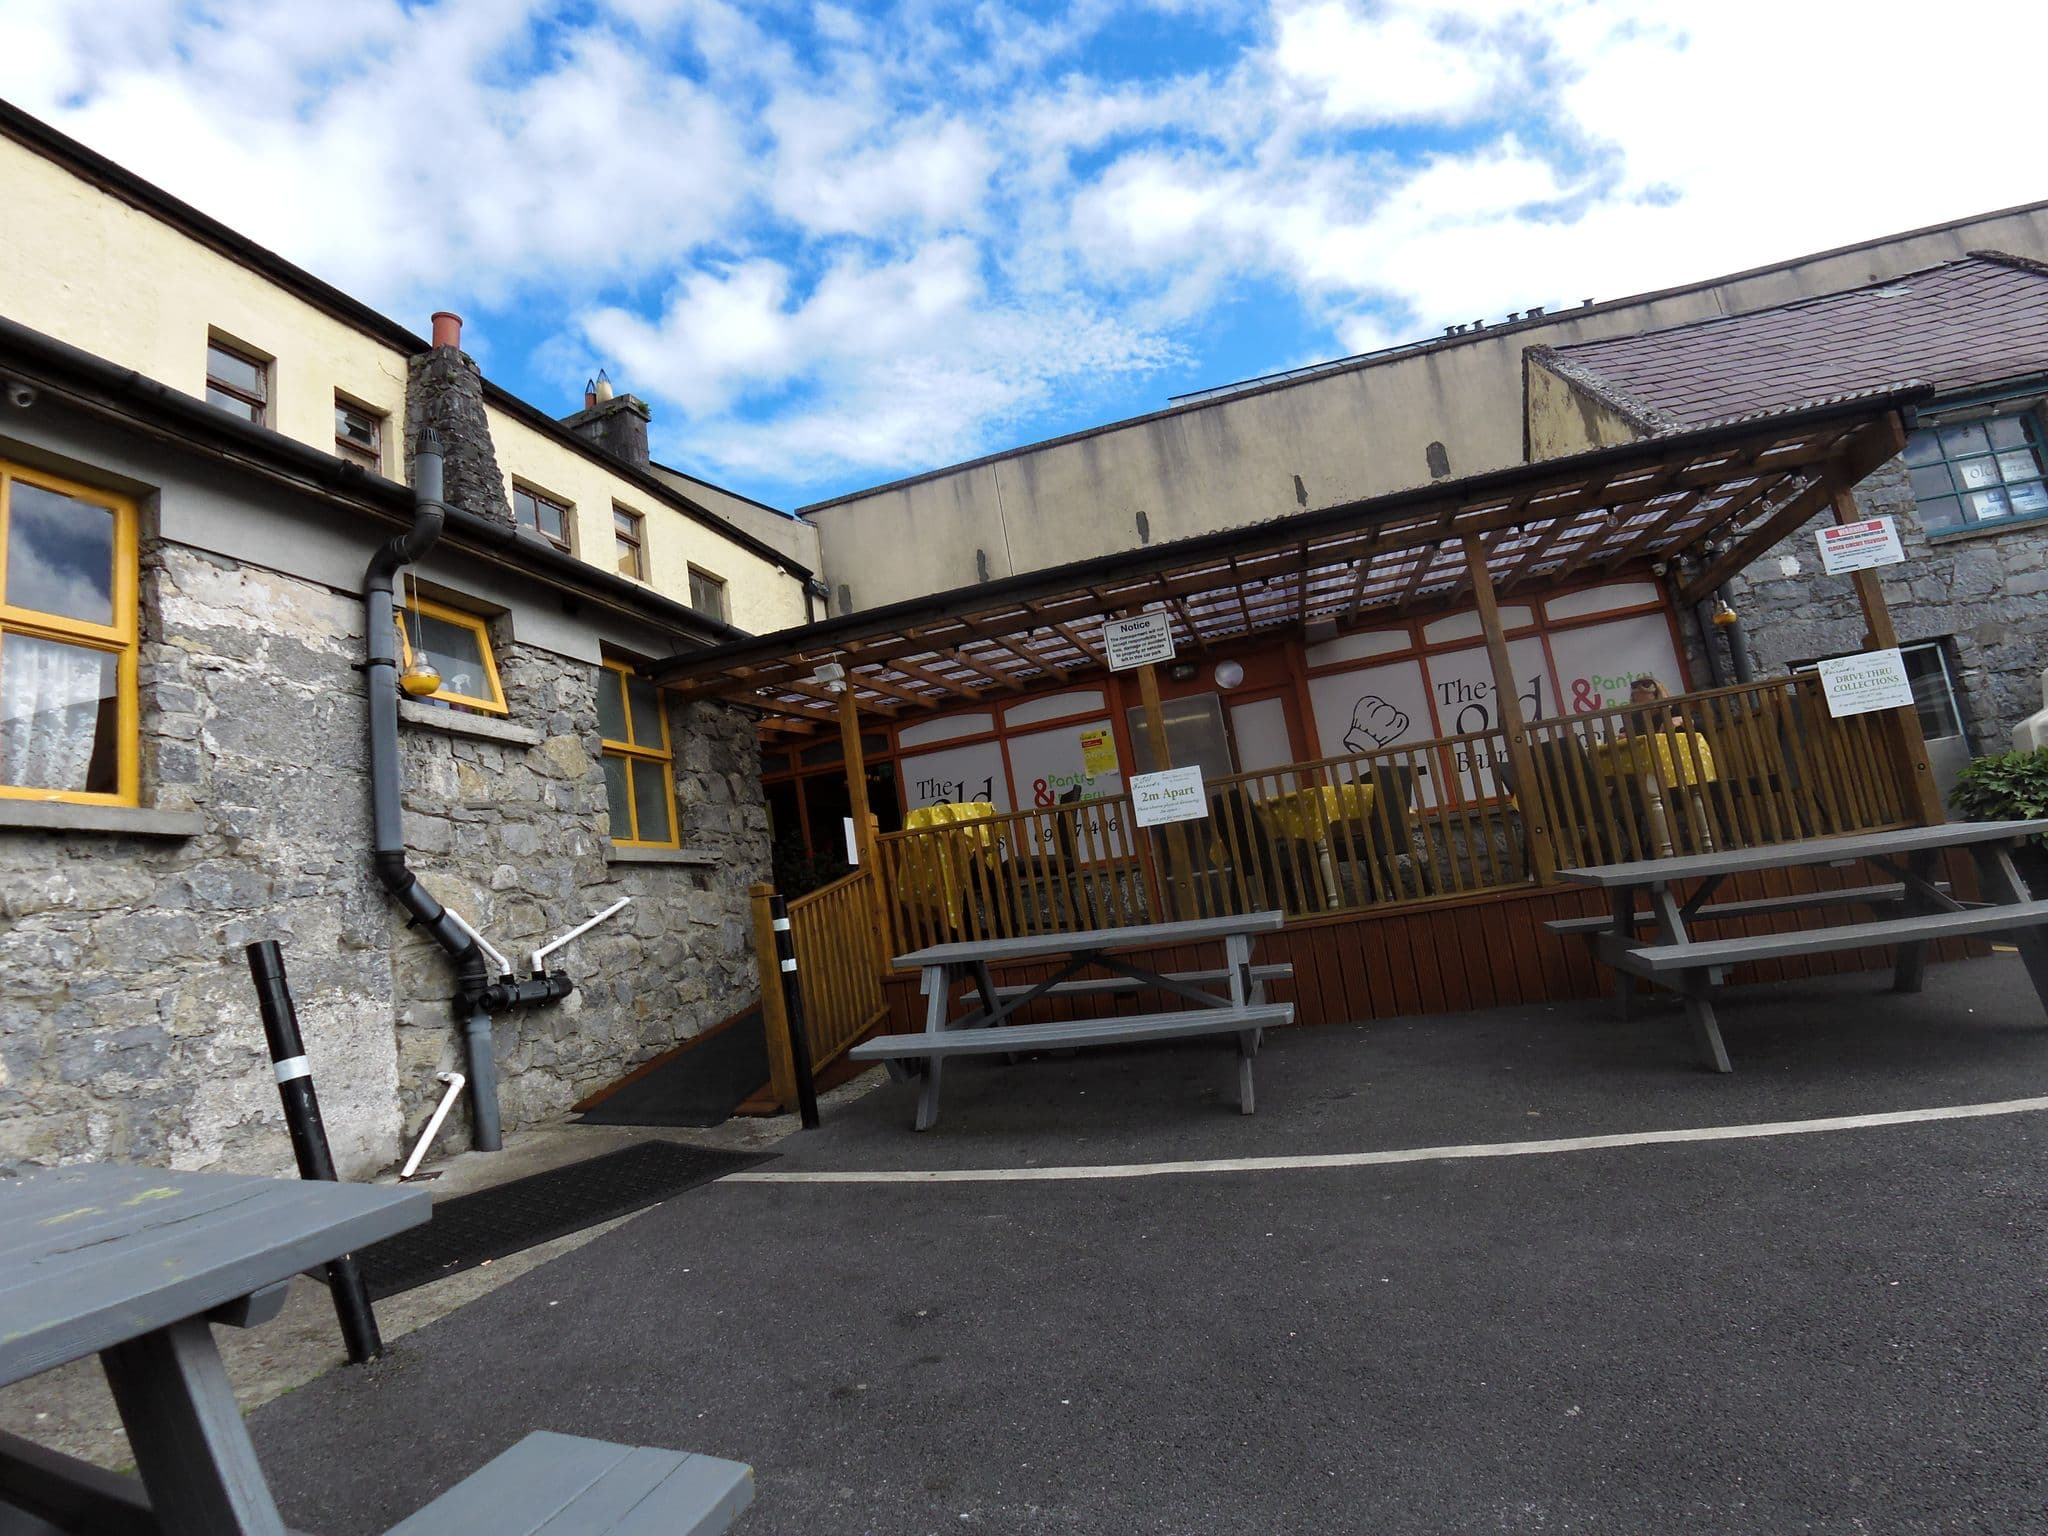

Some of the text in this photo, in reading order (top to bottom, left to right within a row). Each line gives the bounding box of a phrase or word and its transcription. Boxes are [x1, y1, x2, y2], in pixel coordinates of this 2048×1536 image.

[1120, 621, 1150, 632] Notice
[1834, 675, 1899, 693] COLLECTIONS
[1836, 672, 1865, 683] DRIVE
[1867, 667, 1892, 678] THRU
[1438, 678, 1487, 706] The
[1456, 675, 1542, 734] Od
[1572, 678, 1602, 714] &
[916, 777, 952, 800] The
[931, 776, 993, 807] ld
[1033, 778, 1054, 807] &
[1141, 786, 1194, 802] 2m Apart
